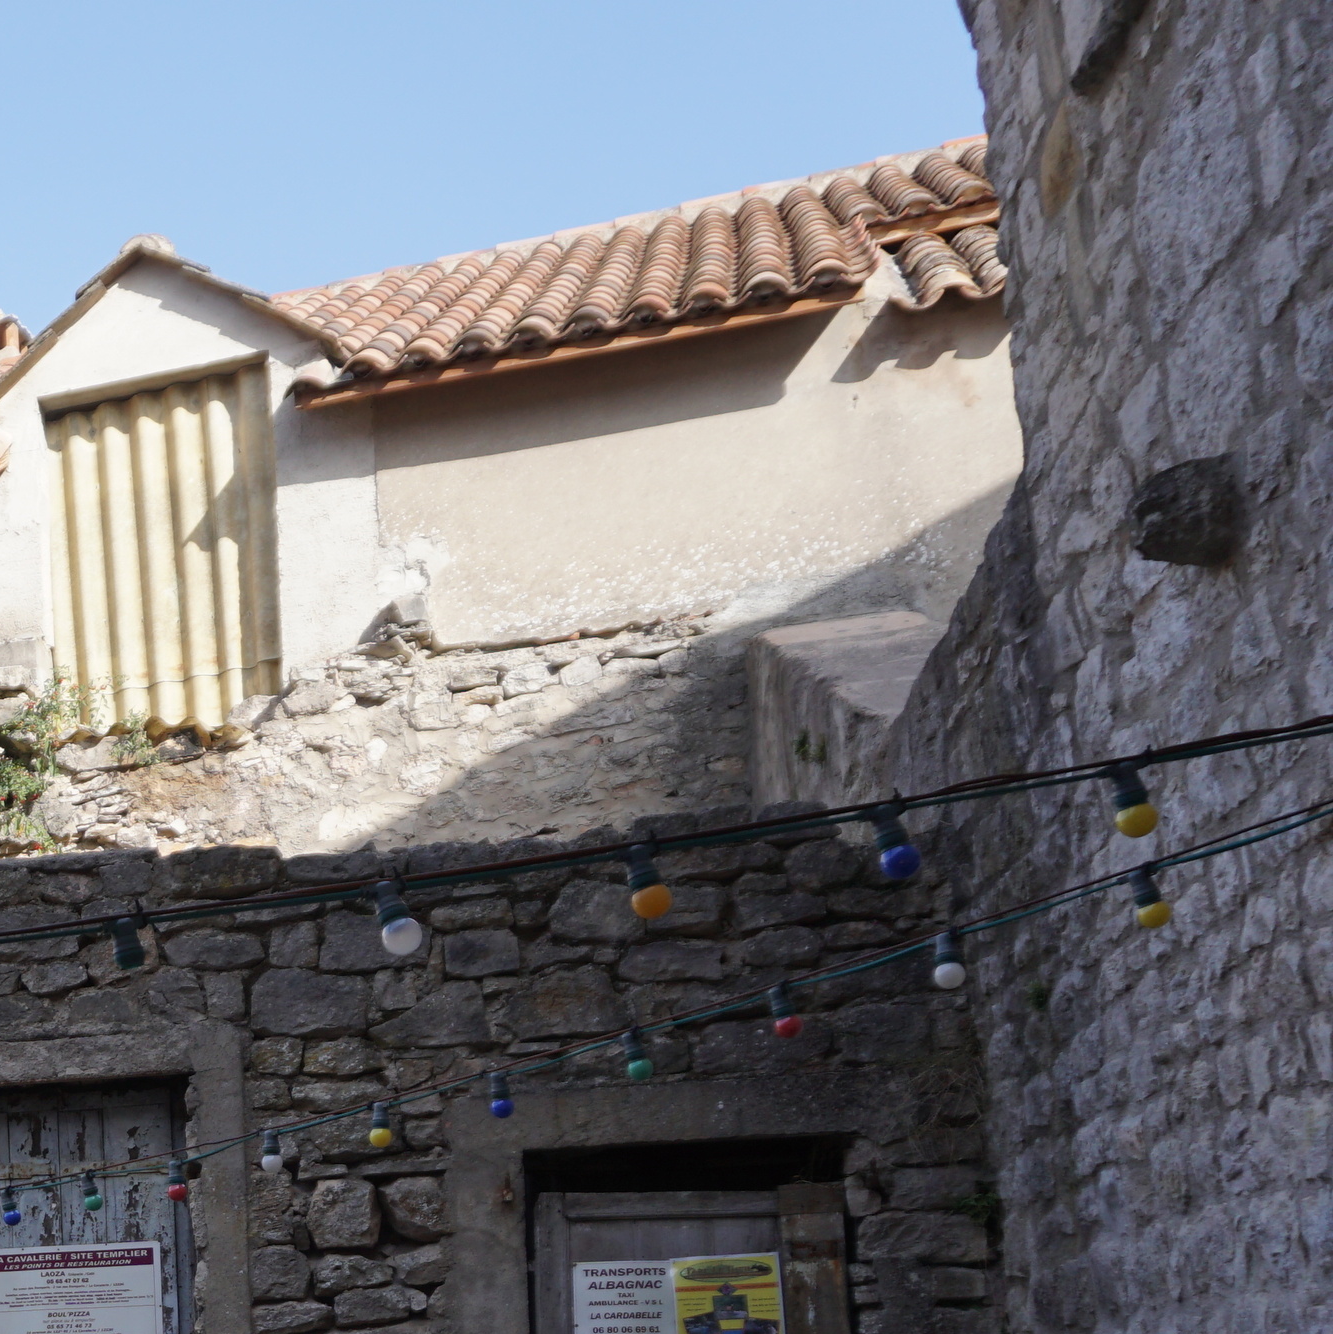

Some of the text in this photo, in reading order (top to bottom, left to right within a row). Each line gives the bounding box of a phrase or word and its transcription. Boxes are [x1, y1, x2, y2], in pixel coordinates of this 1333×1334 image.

[6, 1253, 62, 1263] CAVALERIE
[70, 1252, 93, 1260] SITE
[96, 1249, 148, 1259] TEMPLIER
[66, 1258, 132, 1267] RESTAURATION
[582, 1267, 667, 1277] TRANSPORTS
[588, 1280, 663, 1290] ALBAGNAC
[604, 1311, 663, 1319] CARDABELLE
